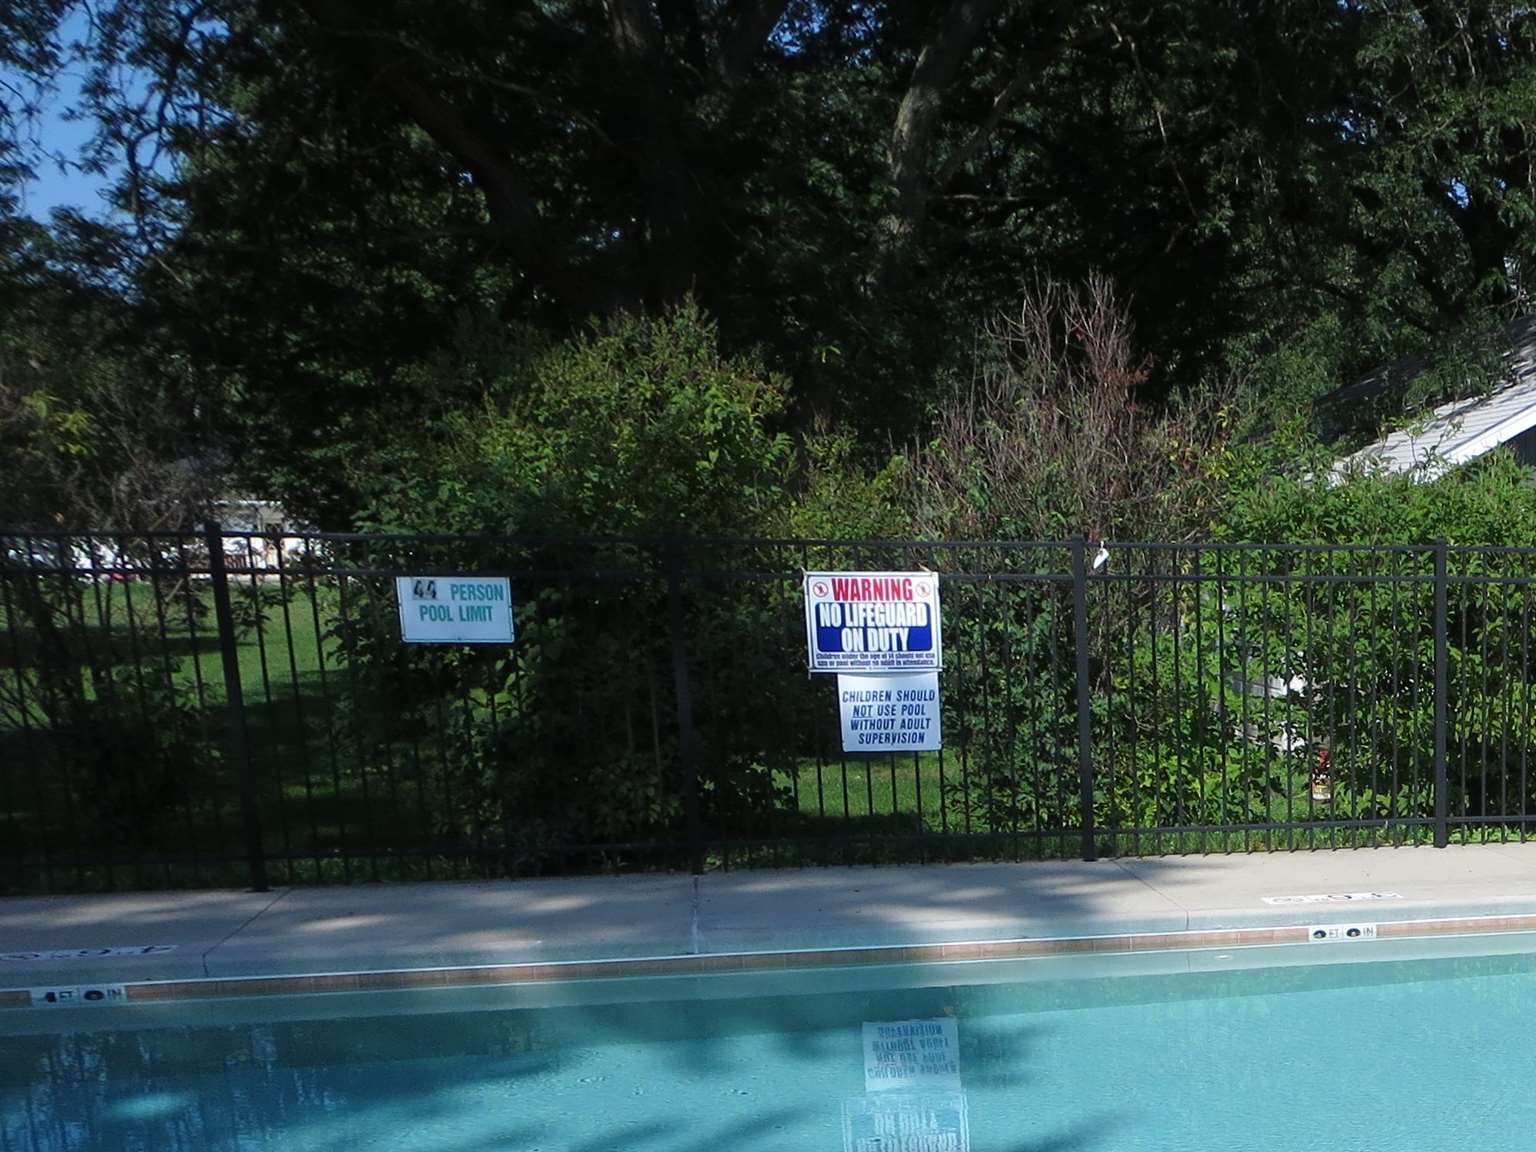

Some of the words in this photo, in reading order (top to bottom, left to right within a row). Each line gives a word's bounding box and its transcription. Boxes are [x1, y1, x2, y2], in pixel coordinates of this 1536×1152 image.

[413, 579, 437, 599] 44
[450, 583, 504, 601] PERSON
[831, 578, 913, 601] WARNING
[419, 605, 454, 622] POOL
[459, 605, 493, 622] LIMIT
[819, 602, 842, 627] NO
[844, 602, 928, 627] LIFEGUARD
[841, 627, 864, 652] ON
[866, 627, 910, 652] DUTY
[842, 690, 892, 703] CHILDREN
[896, 689, 936, 702] SHOULD
[853, 704, 873, 717] NOT
[877, 704, 896, 716] USE
[901, 703, 926, 716] POOL
[850, 718, 896, 731] WITHOUT
[900, 718, 931, 730] ADULT
[858, 732, 926, 745] SUPERVISION
[1362, 927, 1374, 936] IN
[107, 988, 121, 998] IN
